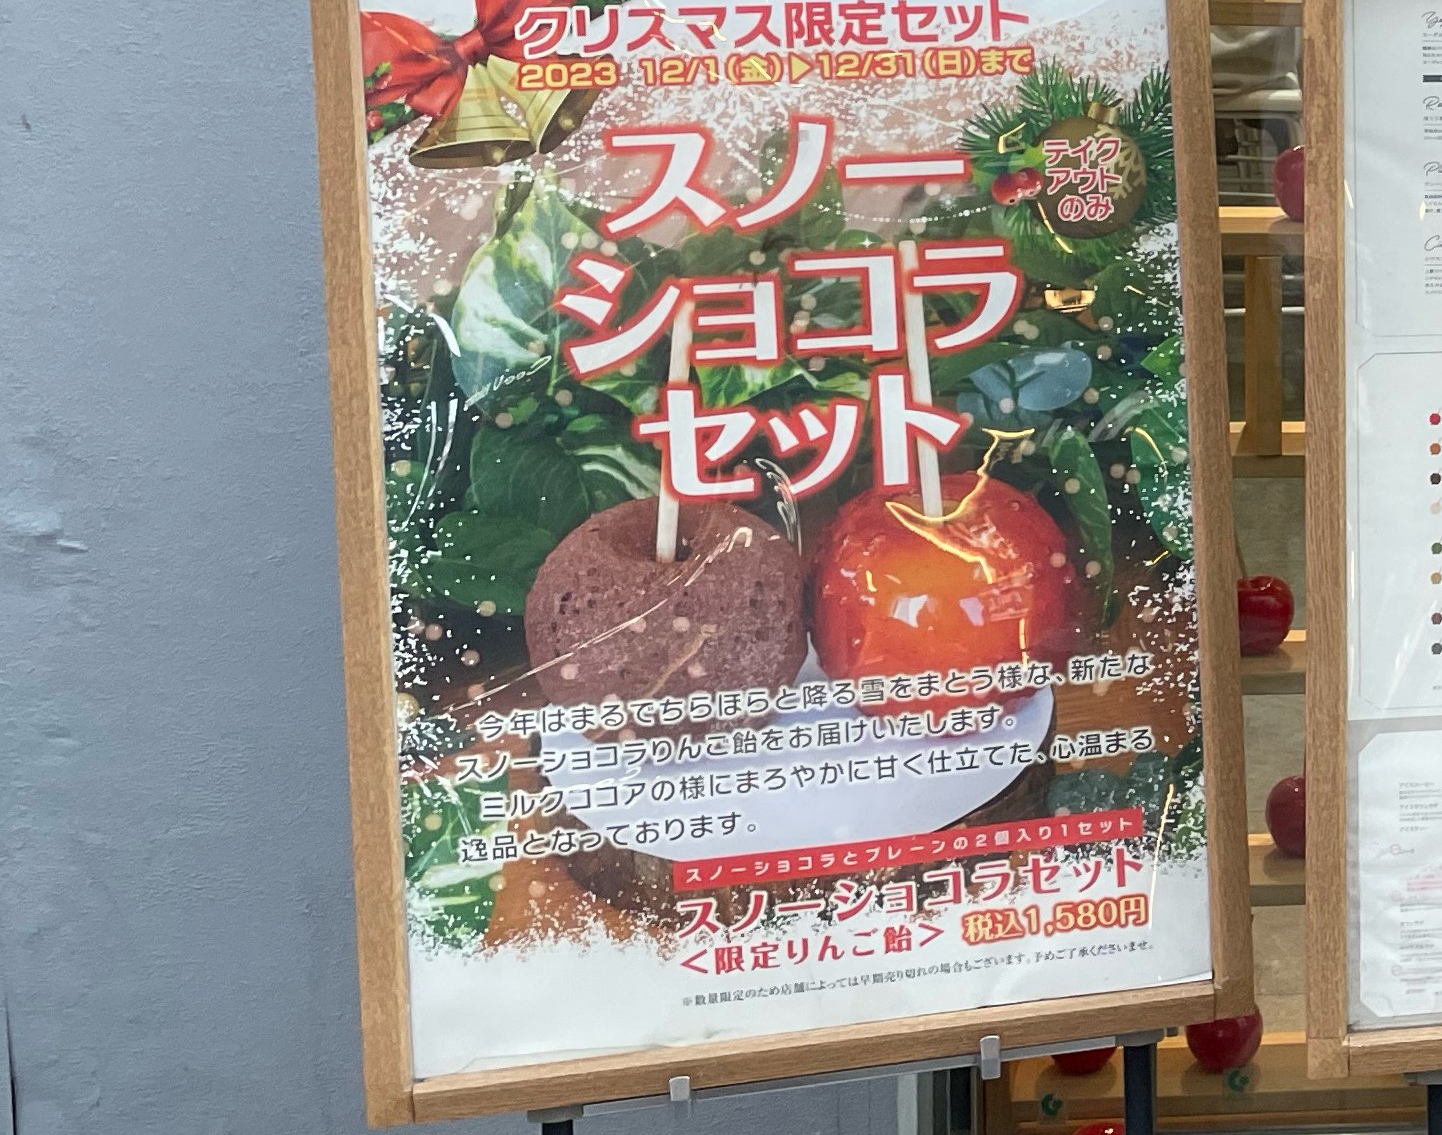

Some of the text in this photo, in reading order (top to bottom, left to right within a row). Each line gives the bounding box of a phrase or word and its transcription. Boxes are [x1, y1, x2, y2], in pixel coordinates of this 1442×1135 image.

[521, 63, 617, 88] 2023
[606, 121, 966, 234] スノー
[1044, 137, 1122, 166] テイク
[1045, 166, 1123, 197] アウト
[1058, 193, 1114, 222] のみ
[561, 245, 1020, 375] ショコラ
[639, 373, 964, 499] セット
[478, 653, 1153, 739] 今年はまるでちらほらと降る雪をまとう様な、新たな
[456, 708, 1016, 783] スノーショコラりんご飴をお届けいたします。
[481, 728, 1154, 819] ミルクココアの様にまろやかに甘く仕立てた、心温まる
[461, 812, 758, 863] 逸品となっております。
[678, 846, 1143, 938] スノーショコラセット
[963, 894, 1149, 944] 税込1,580円
